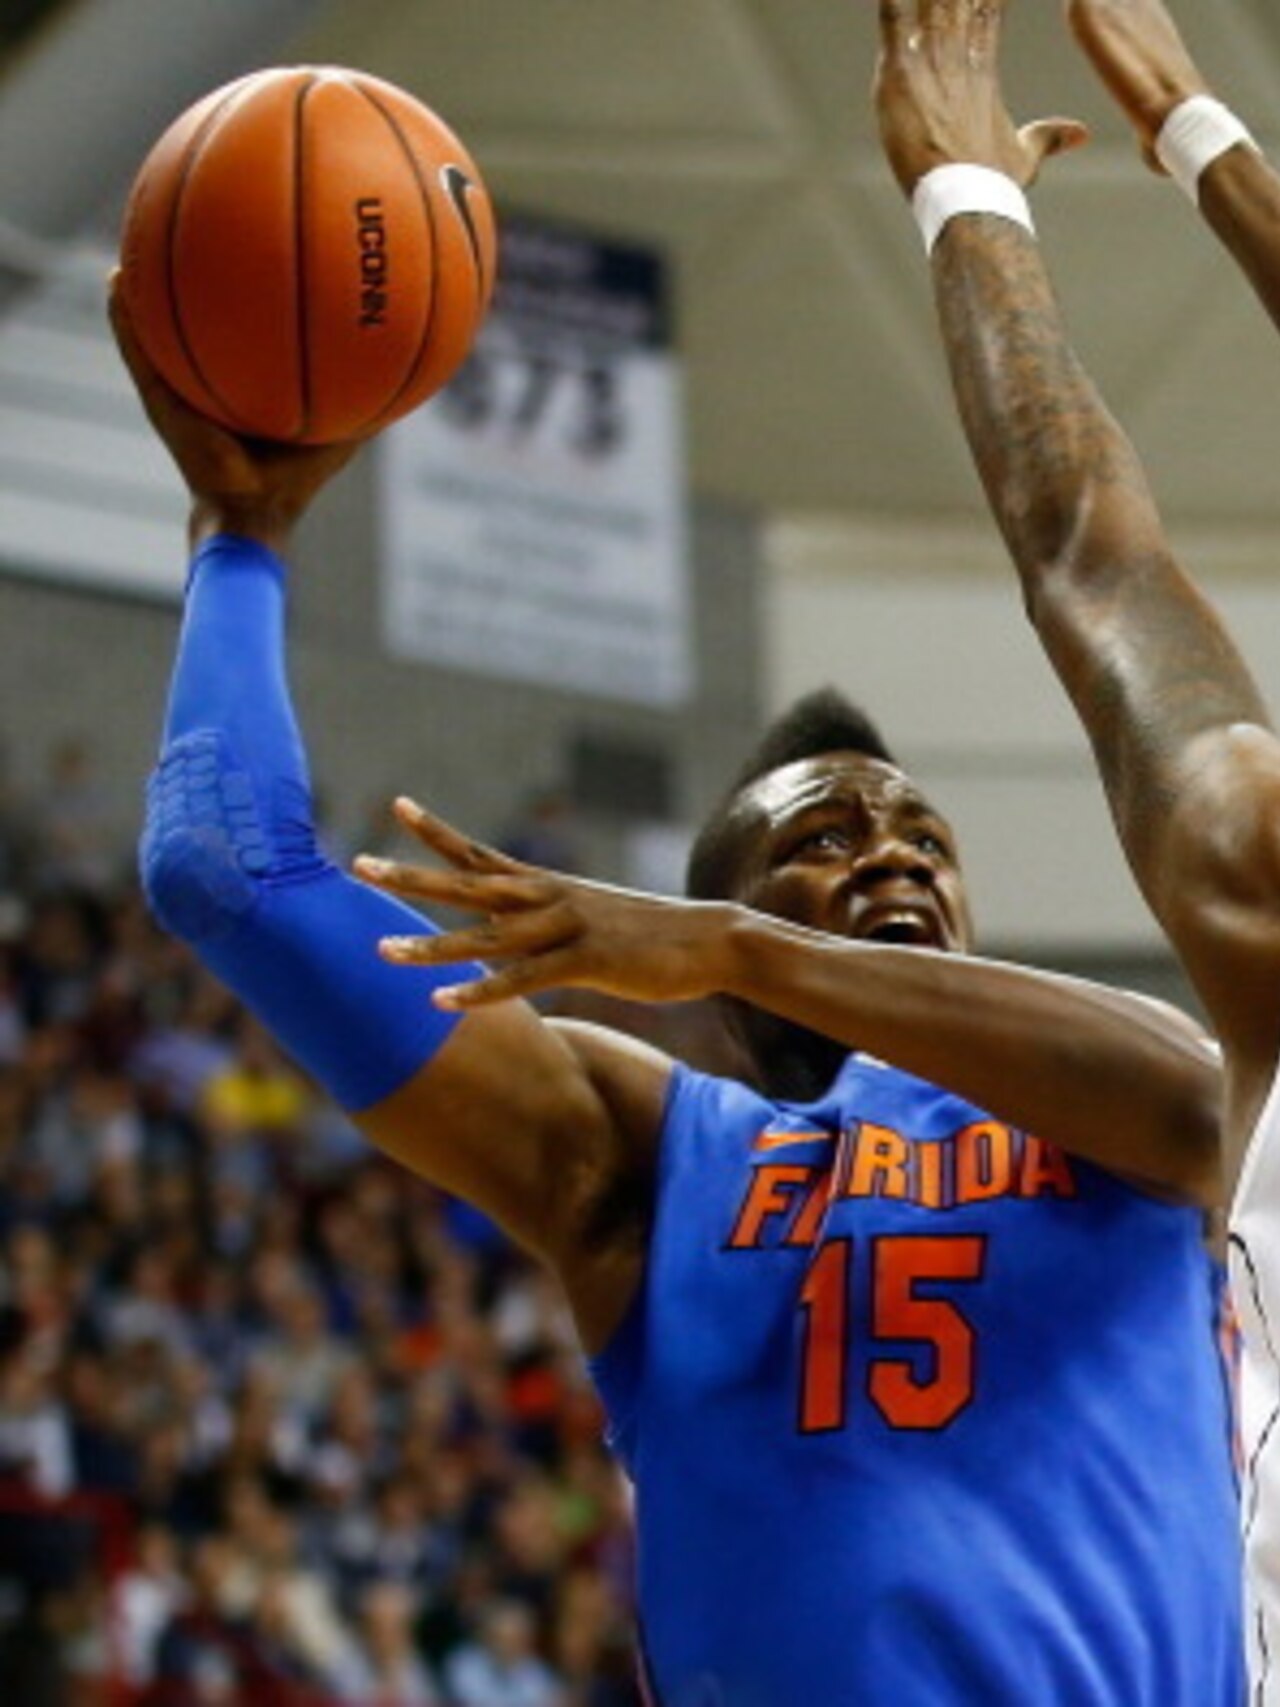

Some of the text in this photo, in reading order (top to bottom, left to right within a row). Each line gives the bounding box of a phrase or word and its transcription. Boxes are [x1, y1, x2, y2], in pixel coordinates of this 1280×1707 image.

[357, 197, 387, 328] UCONN
[722, 1118, 1076, 1249] FLRIDA
[798, 1233, 988, 1434] 15
